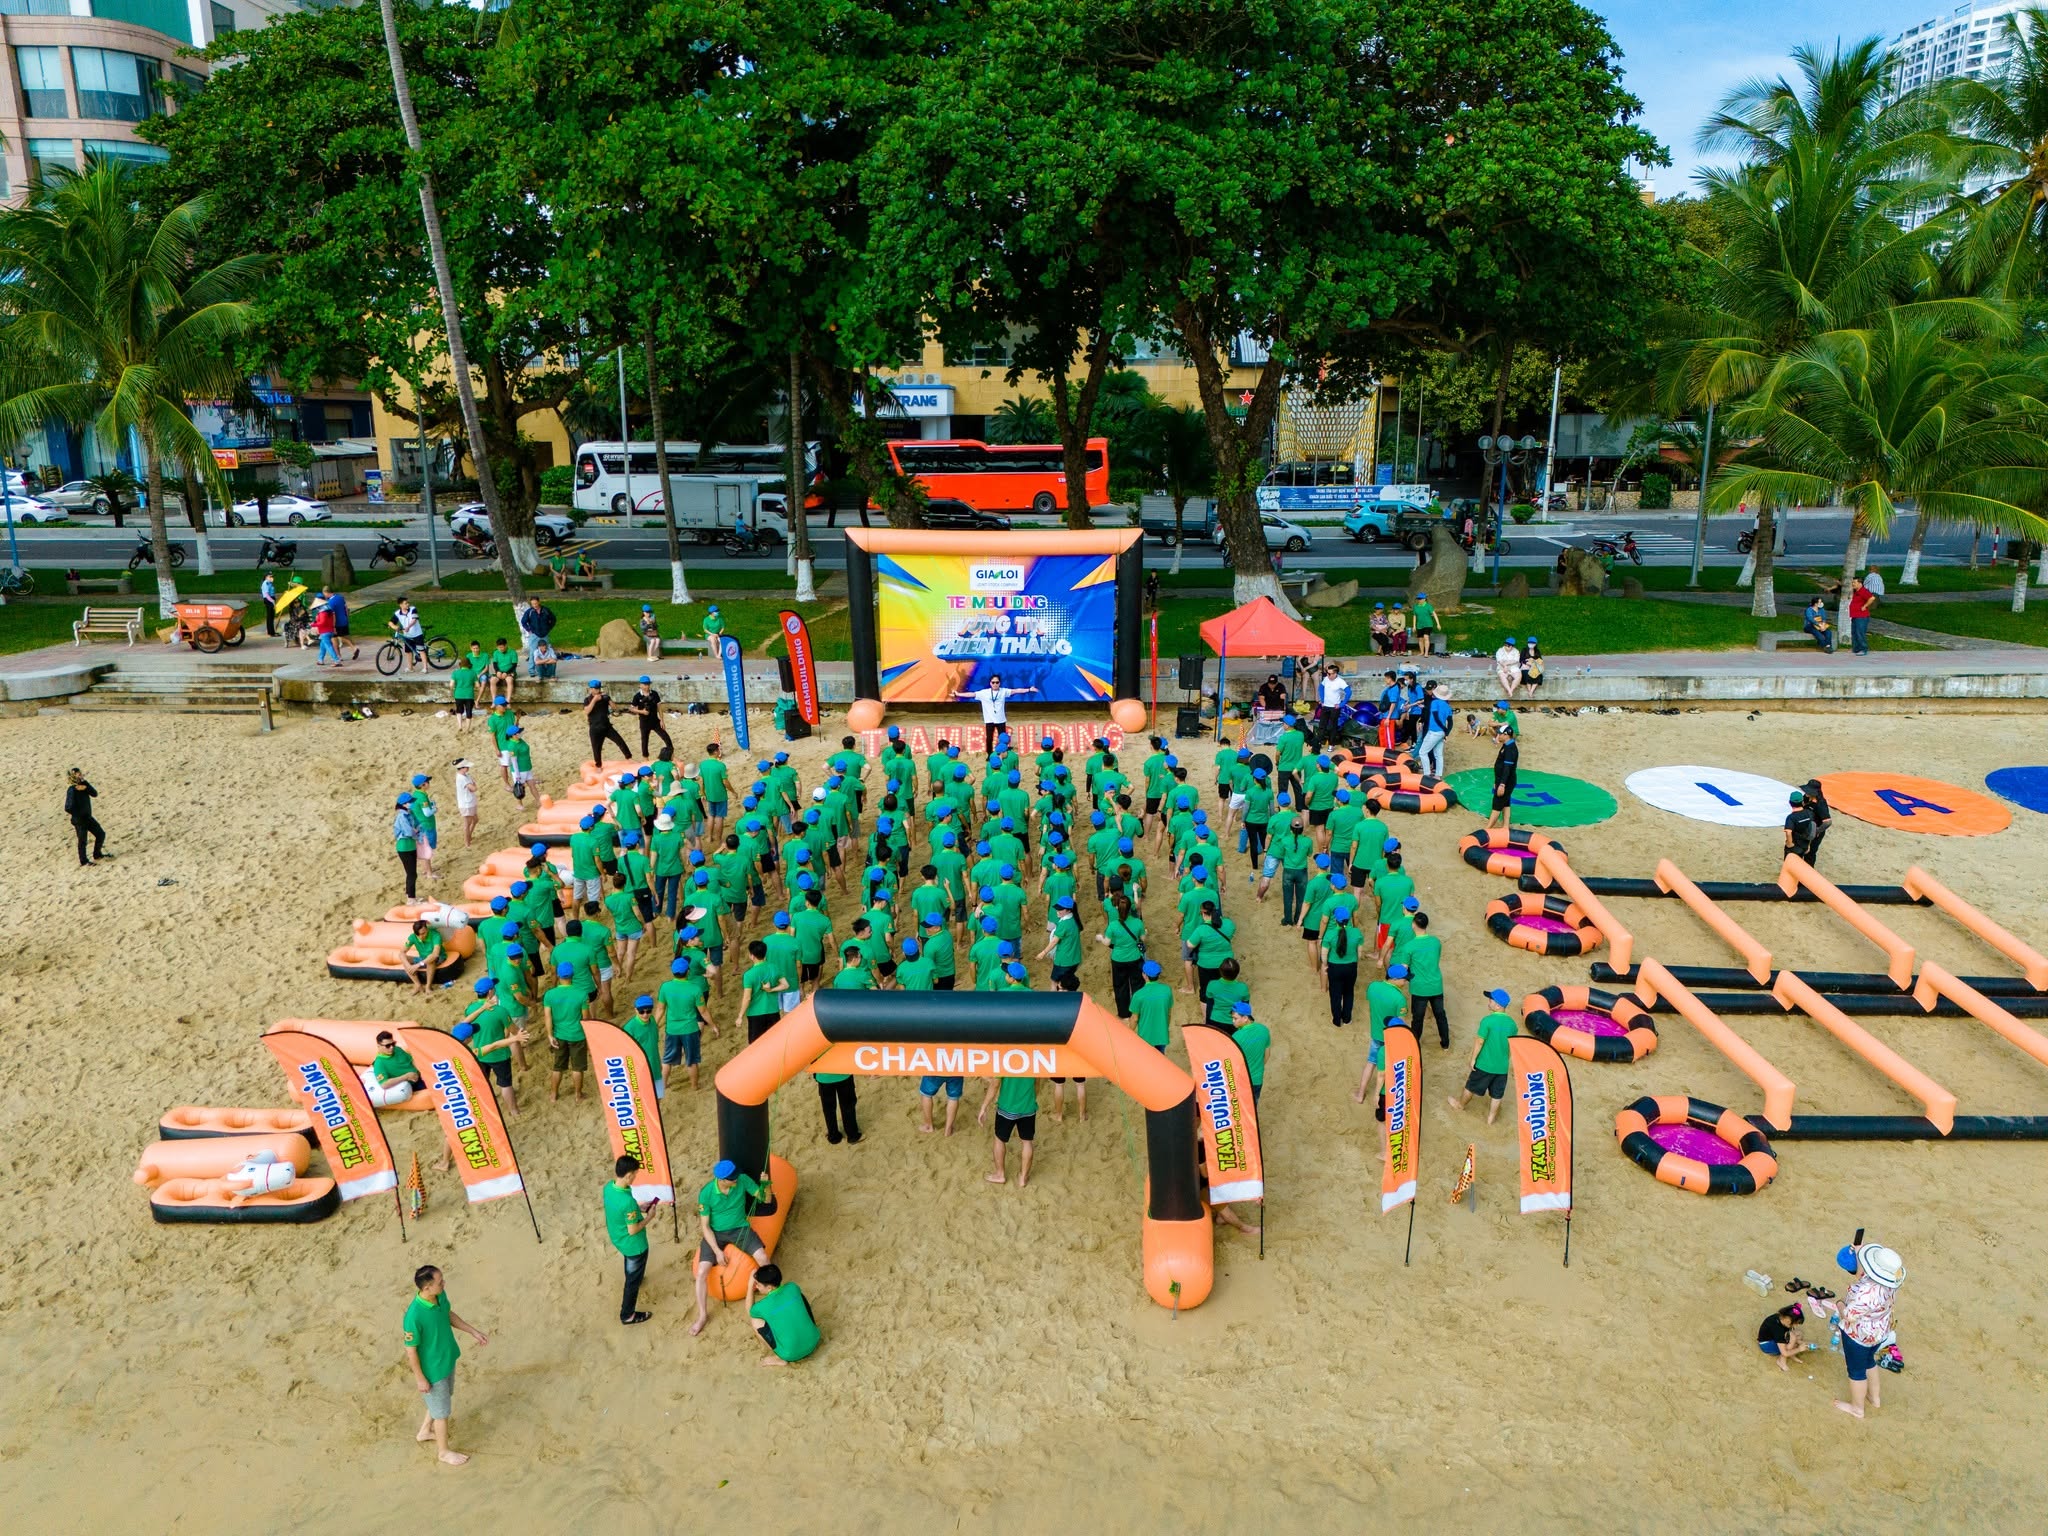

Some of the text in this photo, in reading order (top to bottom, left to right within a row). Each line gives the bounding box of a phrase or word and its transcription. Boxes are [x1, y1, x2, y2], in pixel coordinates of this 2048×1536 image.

[976, 570, 1018, 579] GIA LOI
[946, 596, 1047, 609] TEAMBUILDING
[793, 638, 813, 721] TEAMBUILDING
[1873, 788, 1954, 817] A
[854, 1046, 1057, 1074] CHAMPION
[330, 1123, 363, 1169] TEAM
[457, 1125, 489, 1169] TEAM
[621, 1128, 644, 1168] EAM
[1215, 1128, 1236, 1171] TEAM
[1532, 1140, 1548, 1180] TEAM
